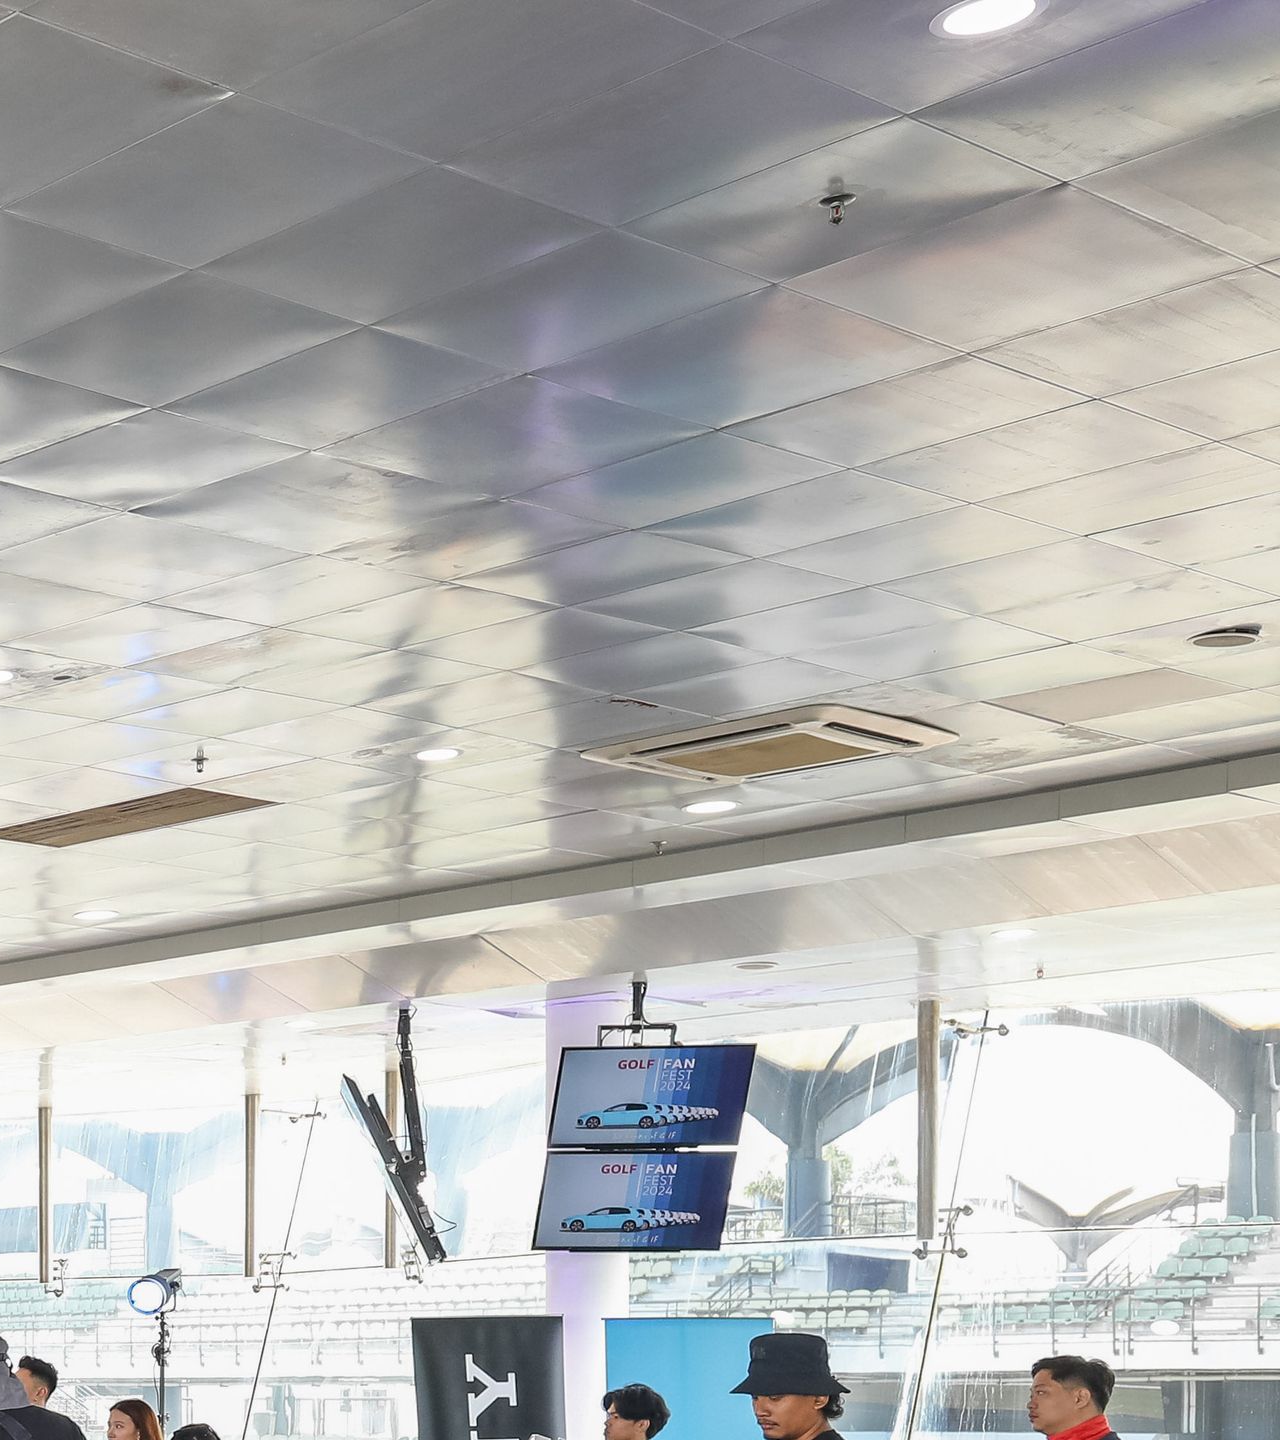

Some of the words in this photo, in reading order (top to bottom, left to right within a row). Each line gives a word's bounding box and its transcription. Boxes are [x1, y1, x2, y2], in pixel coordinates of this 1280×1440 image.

[618, 1059, 656, 1070] GOLF
[663, 1058, 696, 1069] FAN
[661, 1069, 693, 1081] FEST
[659, 1081, 691, 1091] 2024
[601, 1164, 638, 1174] GOLF
[646, 1164, 678, 1174] FAN
[643, 1175, 676, 1186] FEST
[642, 1186, 673, 1196] 2024
